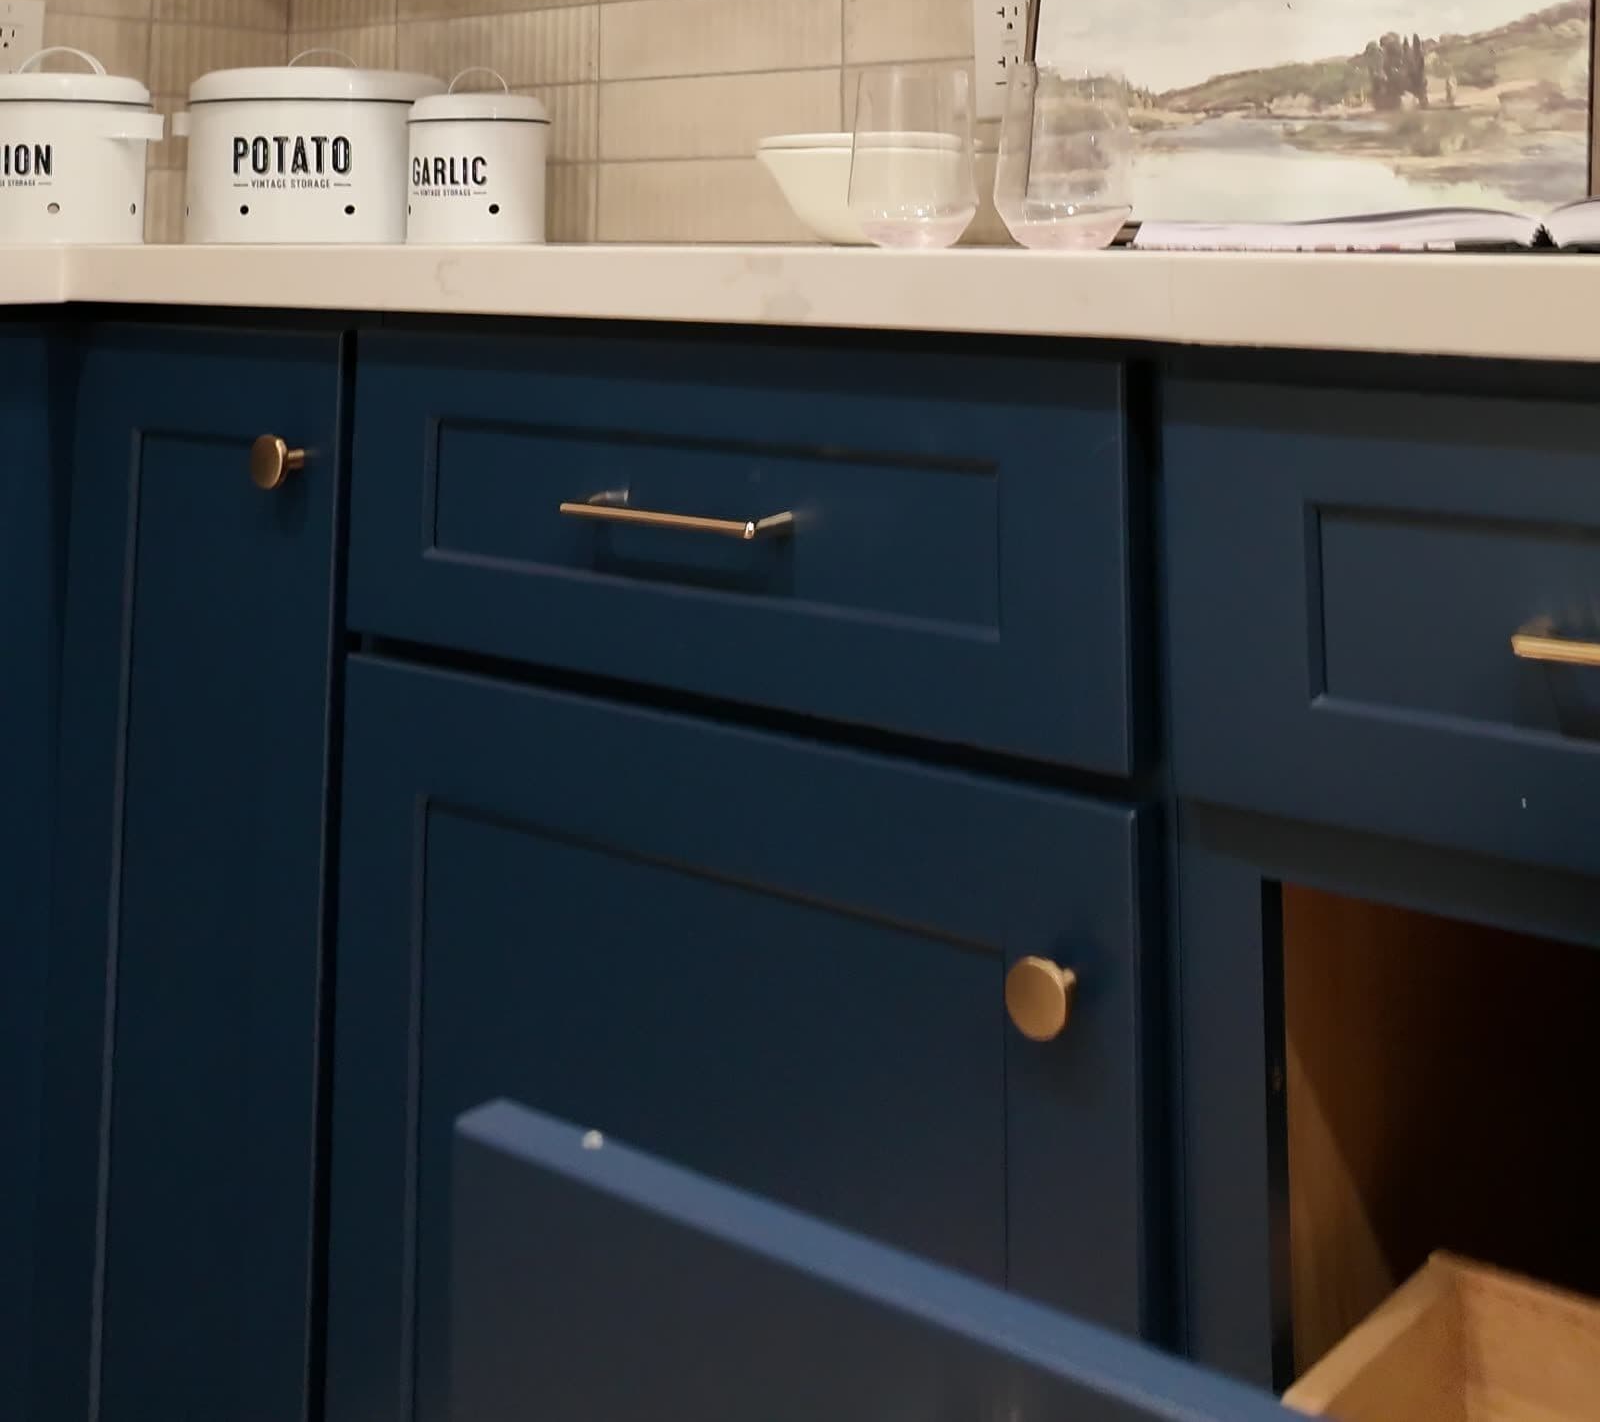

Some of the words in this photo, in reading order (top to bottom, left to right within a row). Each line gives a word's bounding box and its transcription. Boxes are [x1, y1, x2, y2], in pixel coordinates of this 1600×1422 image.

[0, 144, 52, 175] ION
[233, 136, 352, 174] POTATO
[251, 179, 286, 188] VINTAGE
[290, 179, 330, 188] STORAGE
[413, 157, 487, 185] GARLIC
